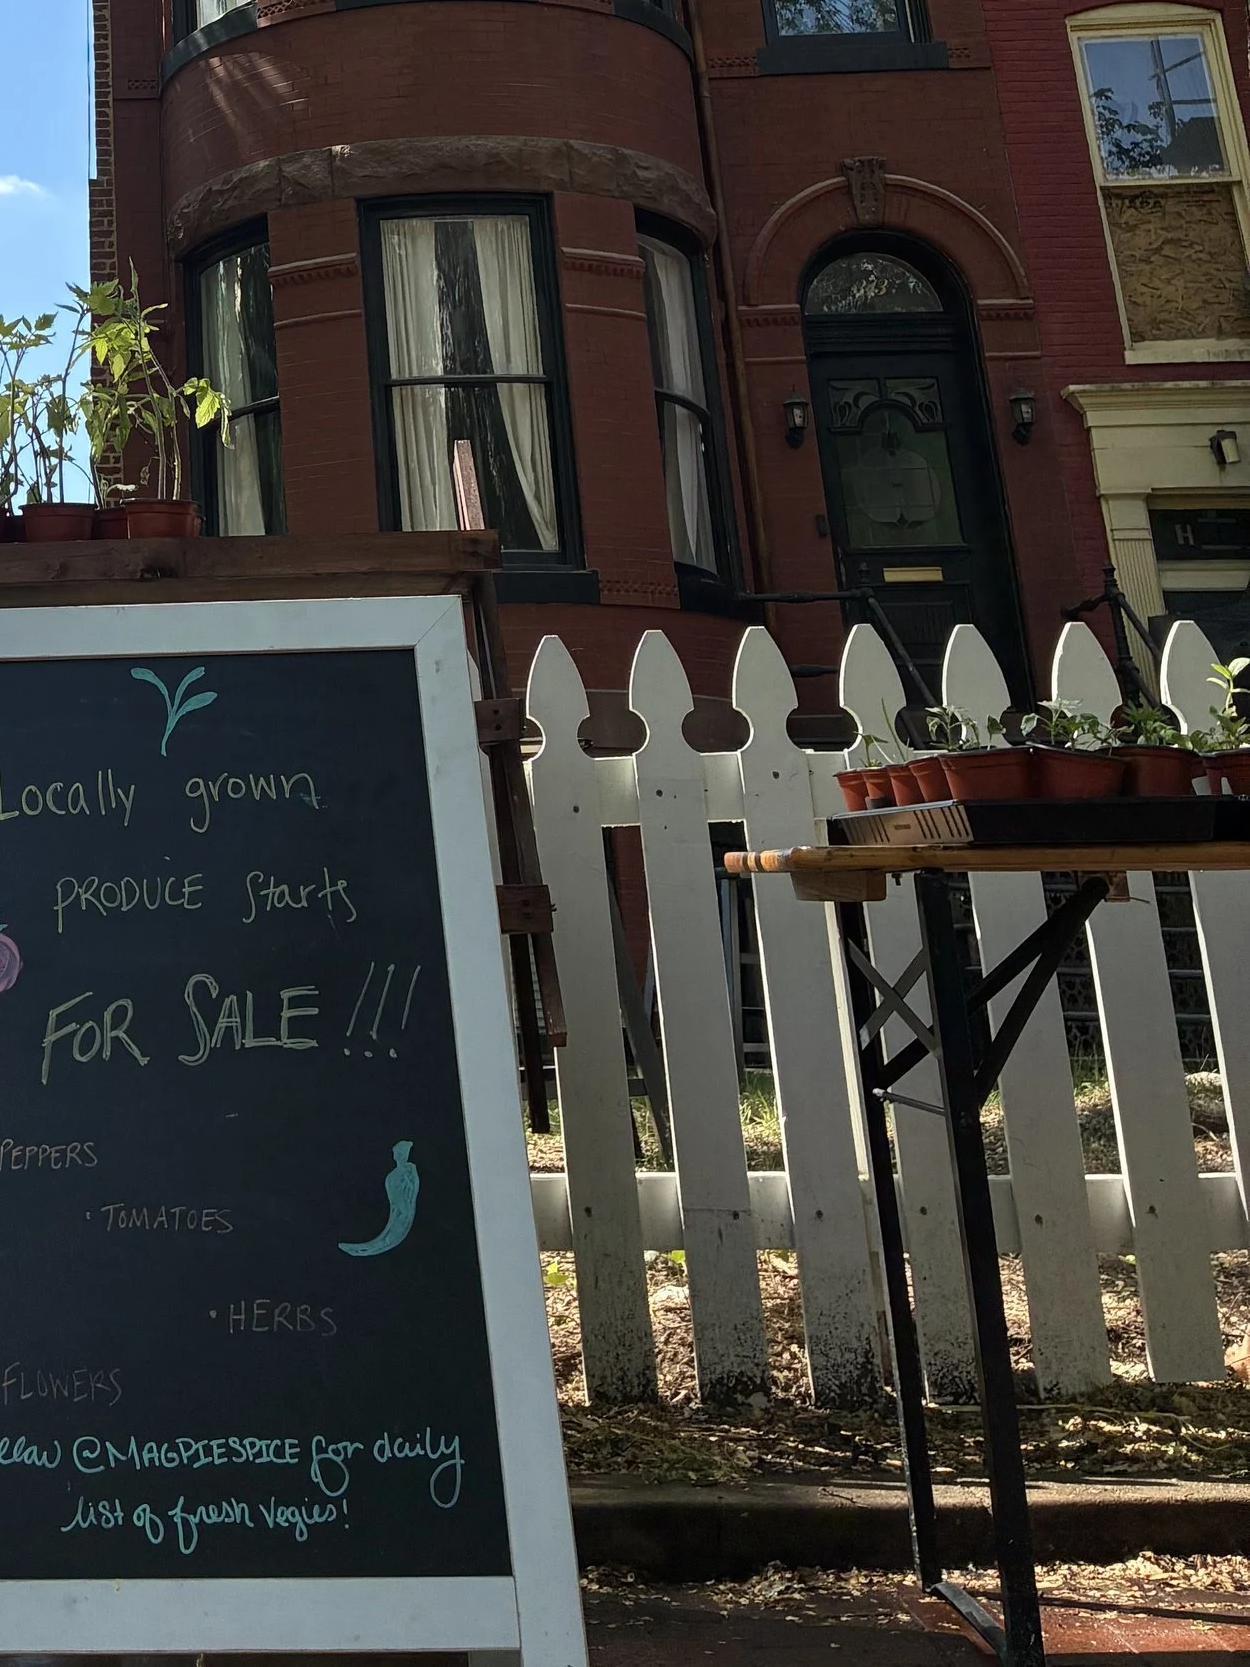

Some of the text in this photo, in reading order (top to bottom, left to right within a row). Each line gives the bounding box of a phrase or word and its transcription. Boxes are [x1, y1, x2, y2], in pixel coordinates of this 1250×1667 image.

[185, 770, 320, 833] grown
[53, 873, 204, 933] PRODUCE
[40, 991, 150, 1085] FOR
[178, 973, 320, 1067] SALE
[100, 1203, 234, 1234] TOMATOES
[228, 1299, 338, 1335] HERBS
[1, 1361, 124, 1407] FLOWERS
[72, 1435, 300, 1474] @MAGPIESPICE
[373, 1426, 465, 1509] daily
[167, 1496, 254, 1555] fresh
